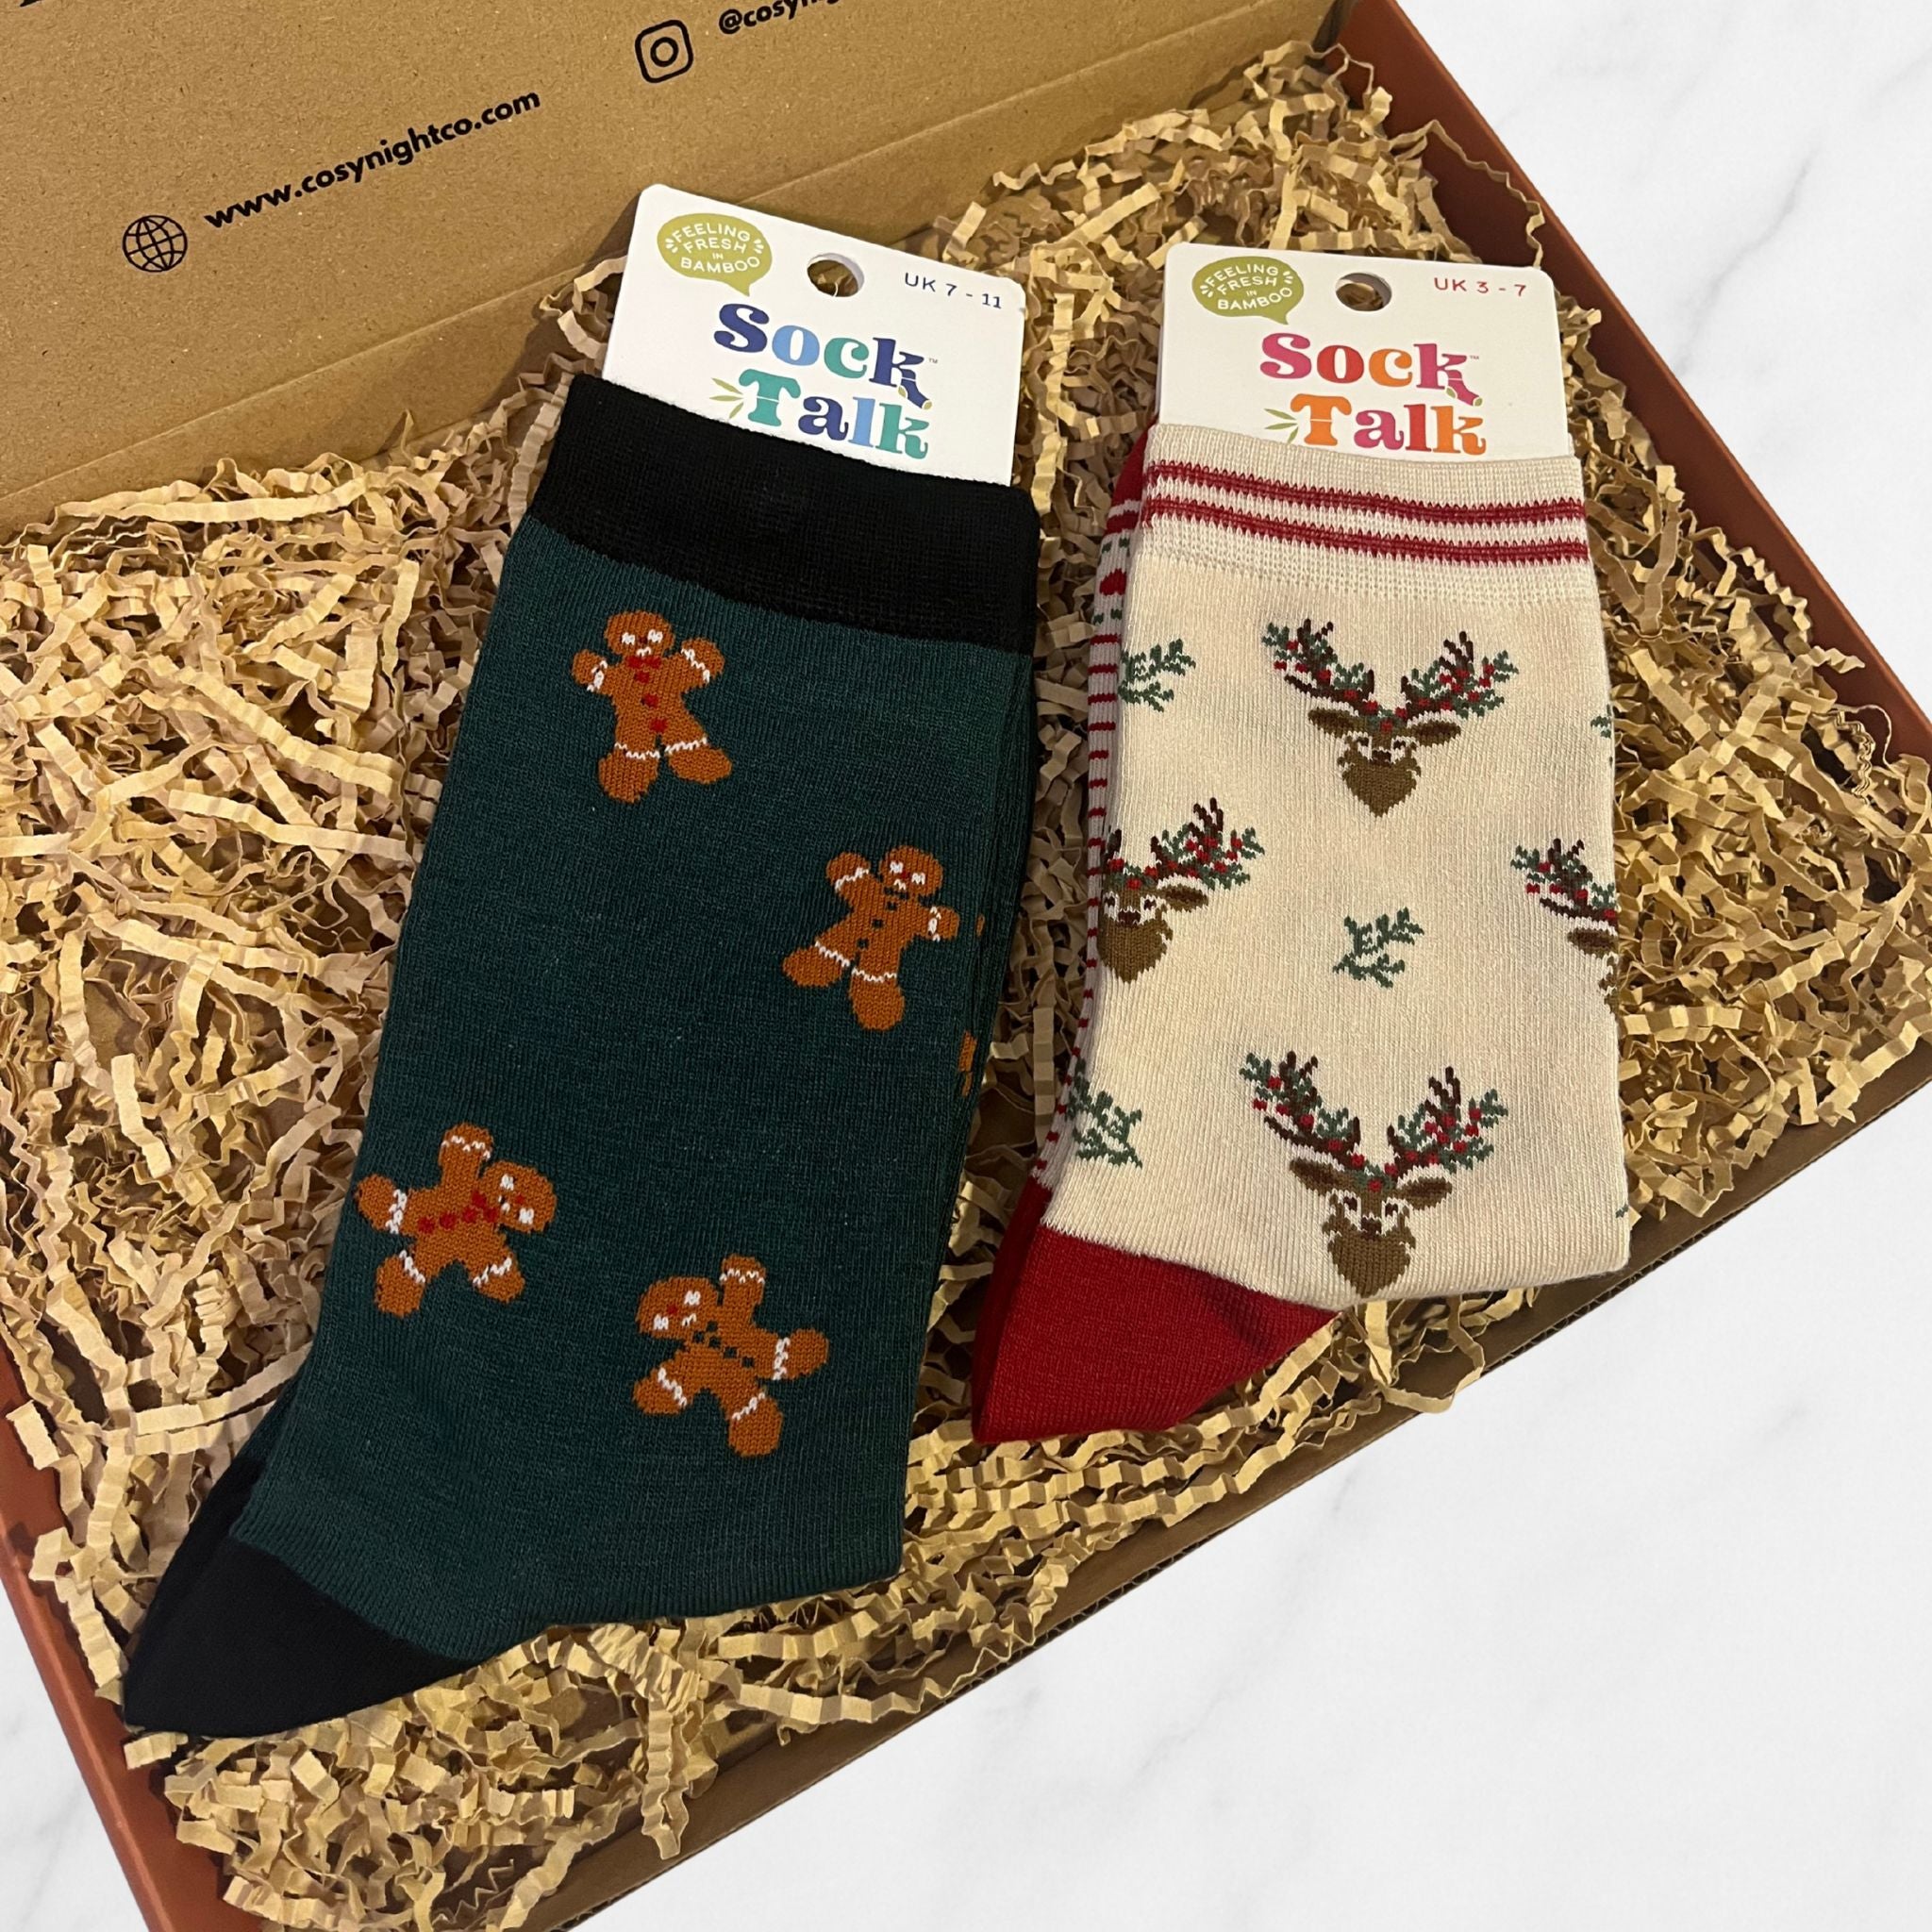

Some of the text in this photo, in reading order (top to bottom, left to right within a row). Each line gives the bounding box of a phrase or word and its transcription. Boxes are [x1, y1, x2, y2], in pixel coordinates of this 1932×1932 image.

[718, 0, 841, 35] @cosy
[204, 92, 541, 228] www.cosynightco.com
[672, 222, 751, 243] FEELING
[683, 237, 747, 254] FRESH
[712, 252, 724, 260] IN
[680, 256, 760, 274] BAMBOO
[1205, 263, 1279, 287] FEELING
[905, 272, 936, 292] UK
[945, 283, 958, 297] 7
[981, 292, 1002, 309] 11
[1217, 275, 1277, 295] FRESH
[1434, 276, 1467, 291] UK
[1476, 281, 1489, 294] 3
[1514, 284, 1526, 297] 7
[1217, 287, 1293, 310] BAMBOO
[713, 303, 933, 410] Sock
[1259, 332, 1483, 407] Sock
[739, 368, 930, 460] Talk
[1290, 392, 1487, 456] Talk
